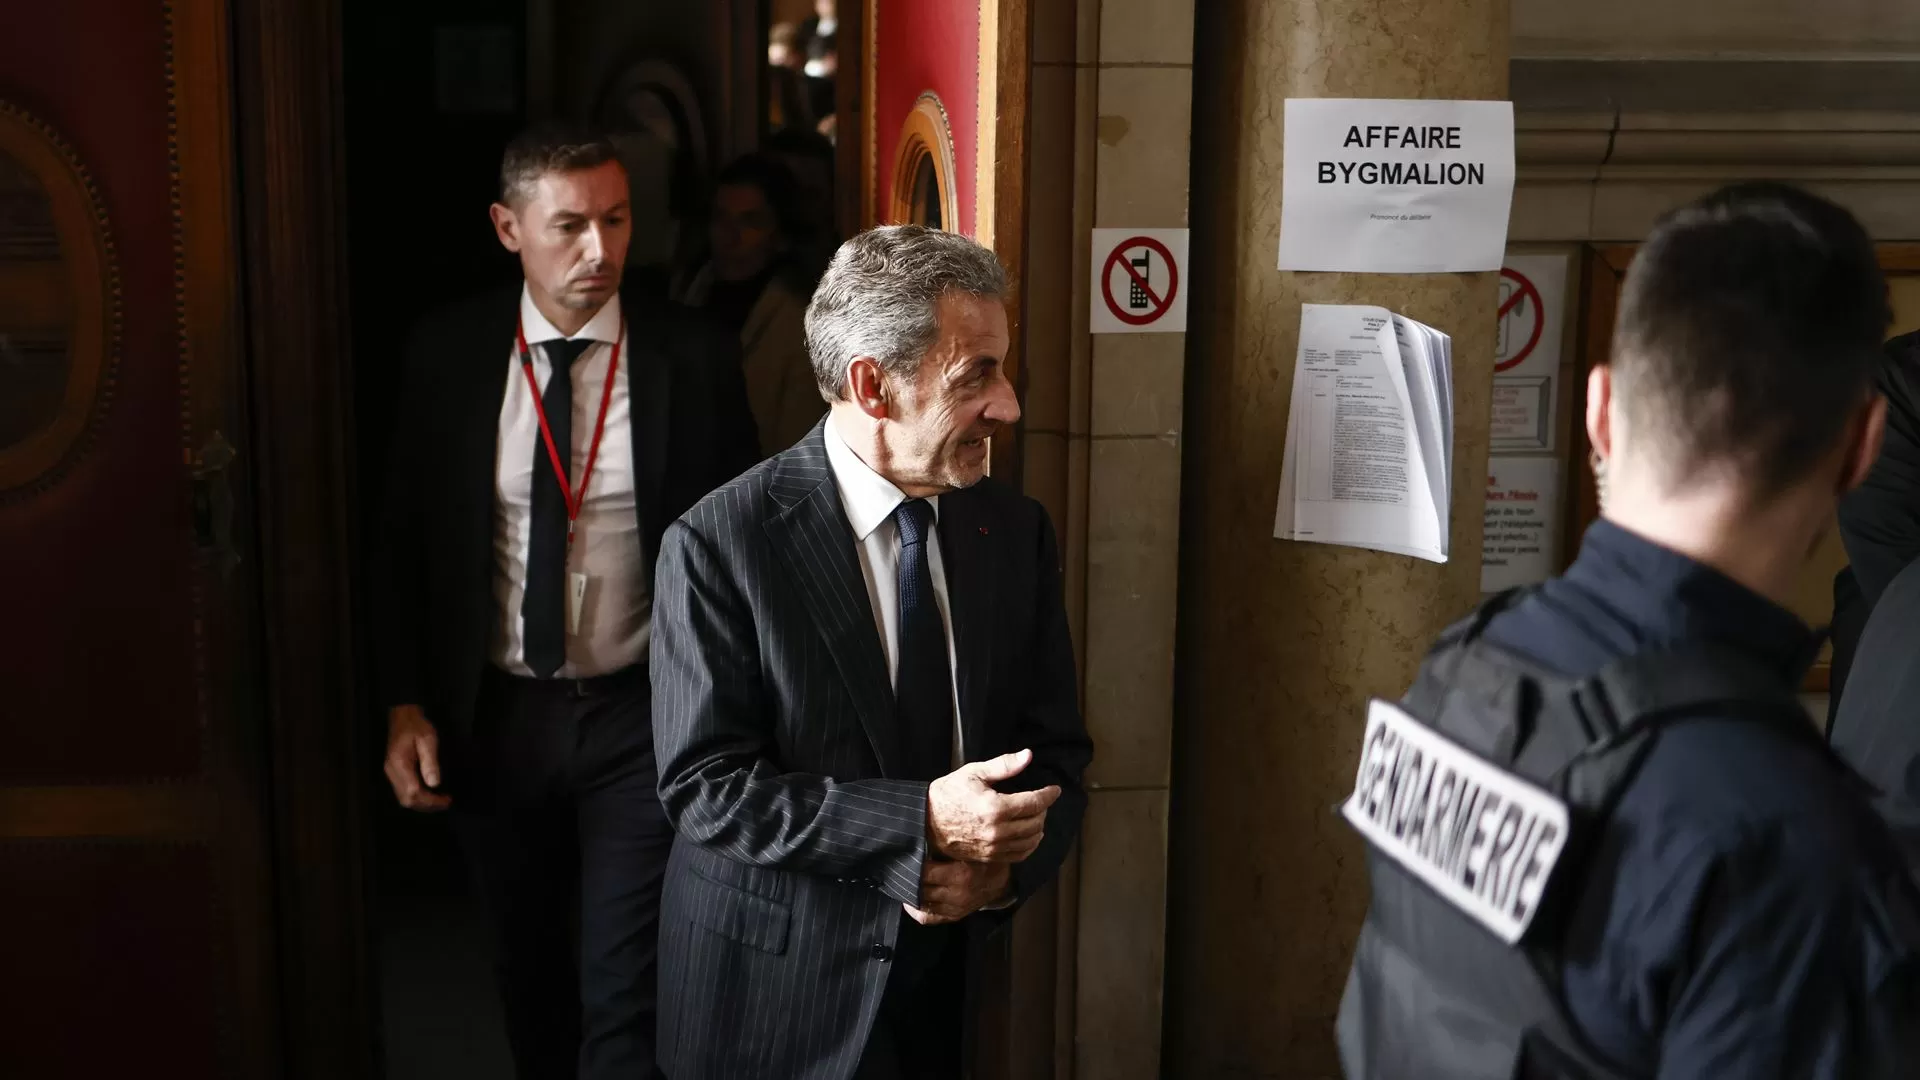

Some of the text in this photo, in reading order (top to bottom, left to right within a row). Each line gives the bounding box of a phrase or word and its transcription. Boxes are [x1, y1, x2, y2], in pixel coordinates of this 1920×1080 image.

[1342, 125, 1461, 149] AFFAIRE
[1317, 161, 1485, 185] BYGMALION
[1358, 720, 1558, 923] GENDARMERIE
